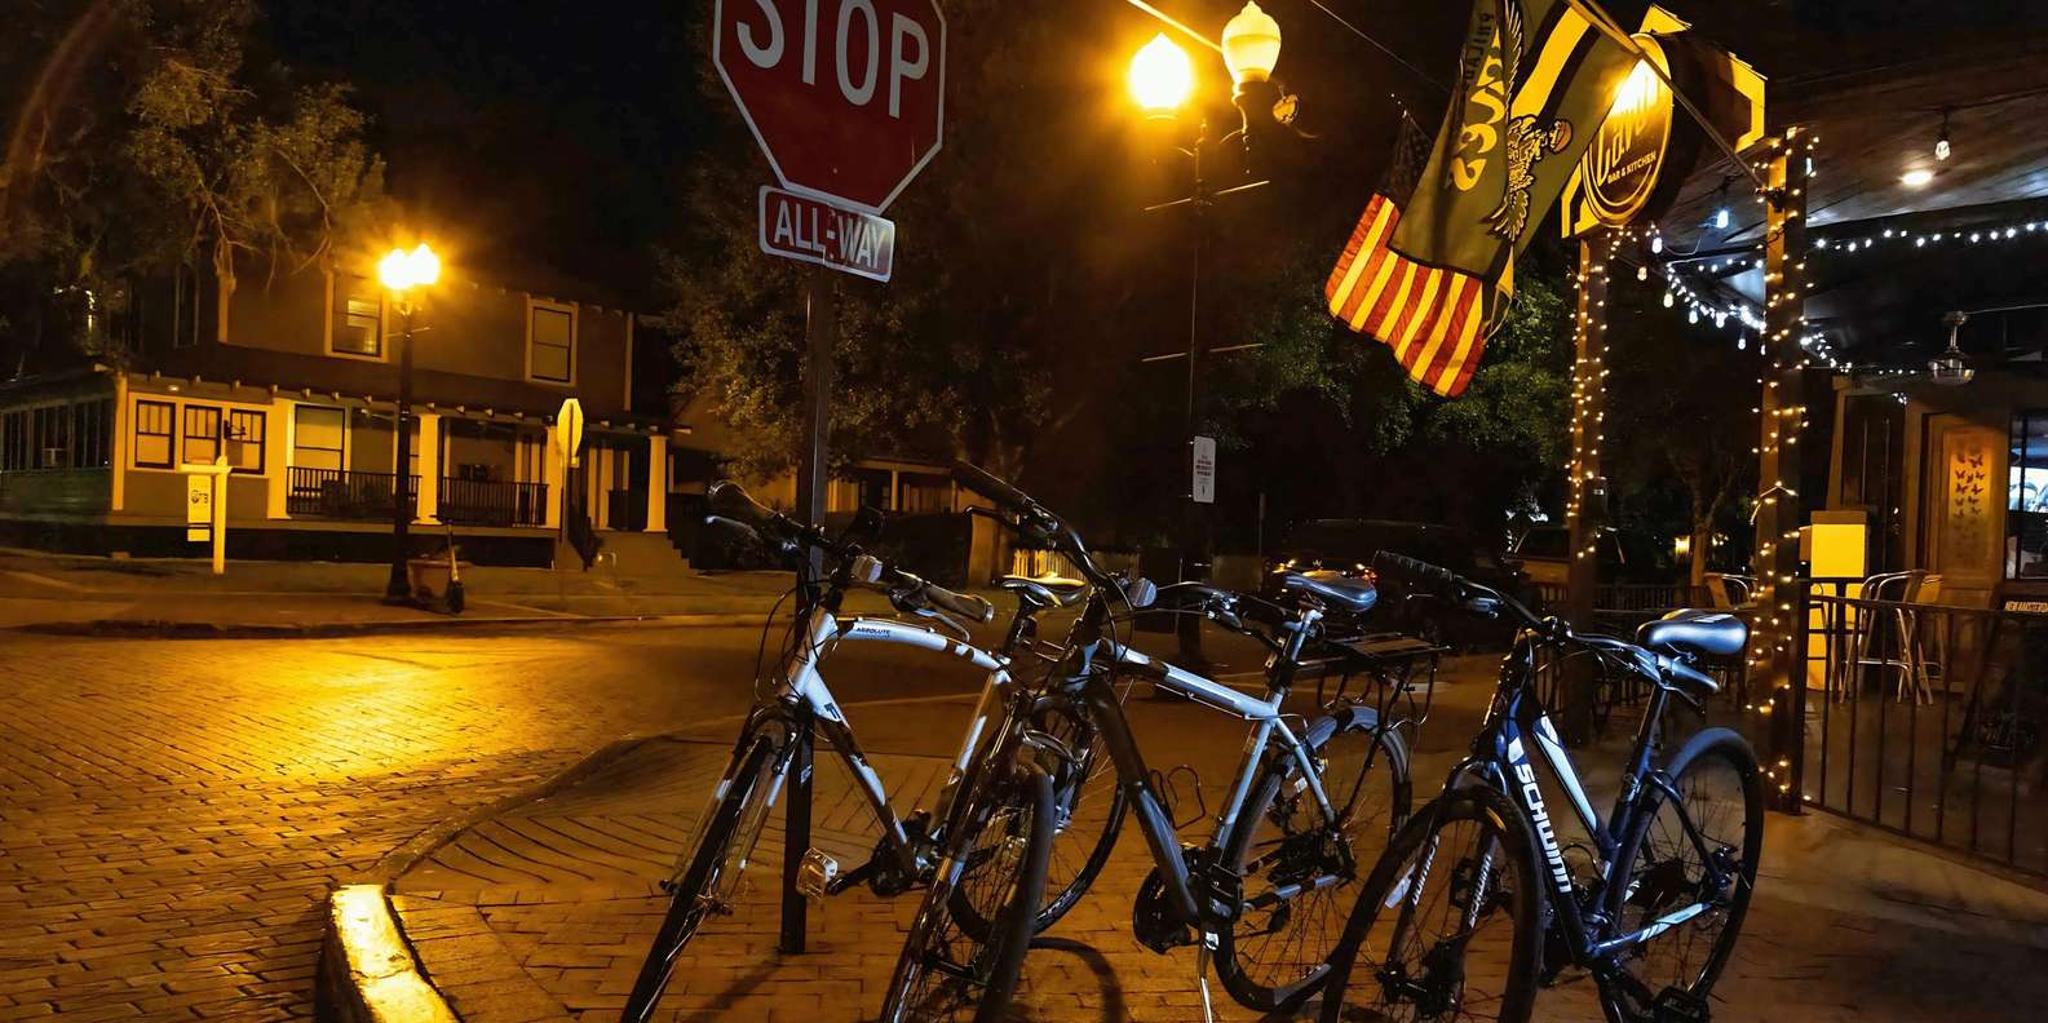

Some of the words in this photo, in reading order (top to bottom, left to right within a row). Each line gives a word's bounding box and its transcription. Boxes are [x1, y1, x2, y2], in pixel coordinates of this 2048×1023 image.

[736, 0, 930, 119] STOP
[1608, 170, 1620, 184] BAR
[1626, 150, 1656, 175] KITCHEN
[774, 200, 886, 269] ALL-WAY
[1515, 763, 1572, 893] SCHWINN
